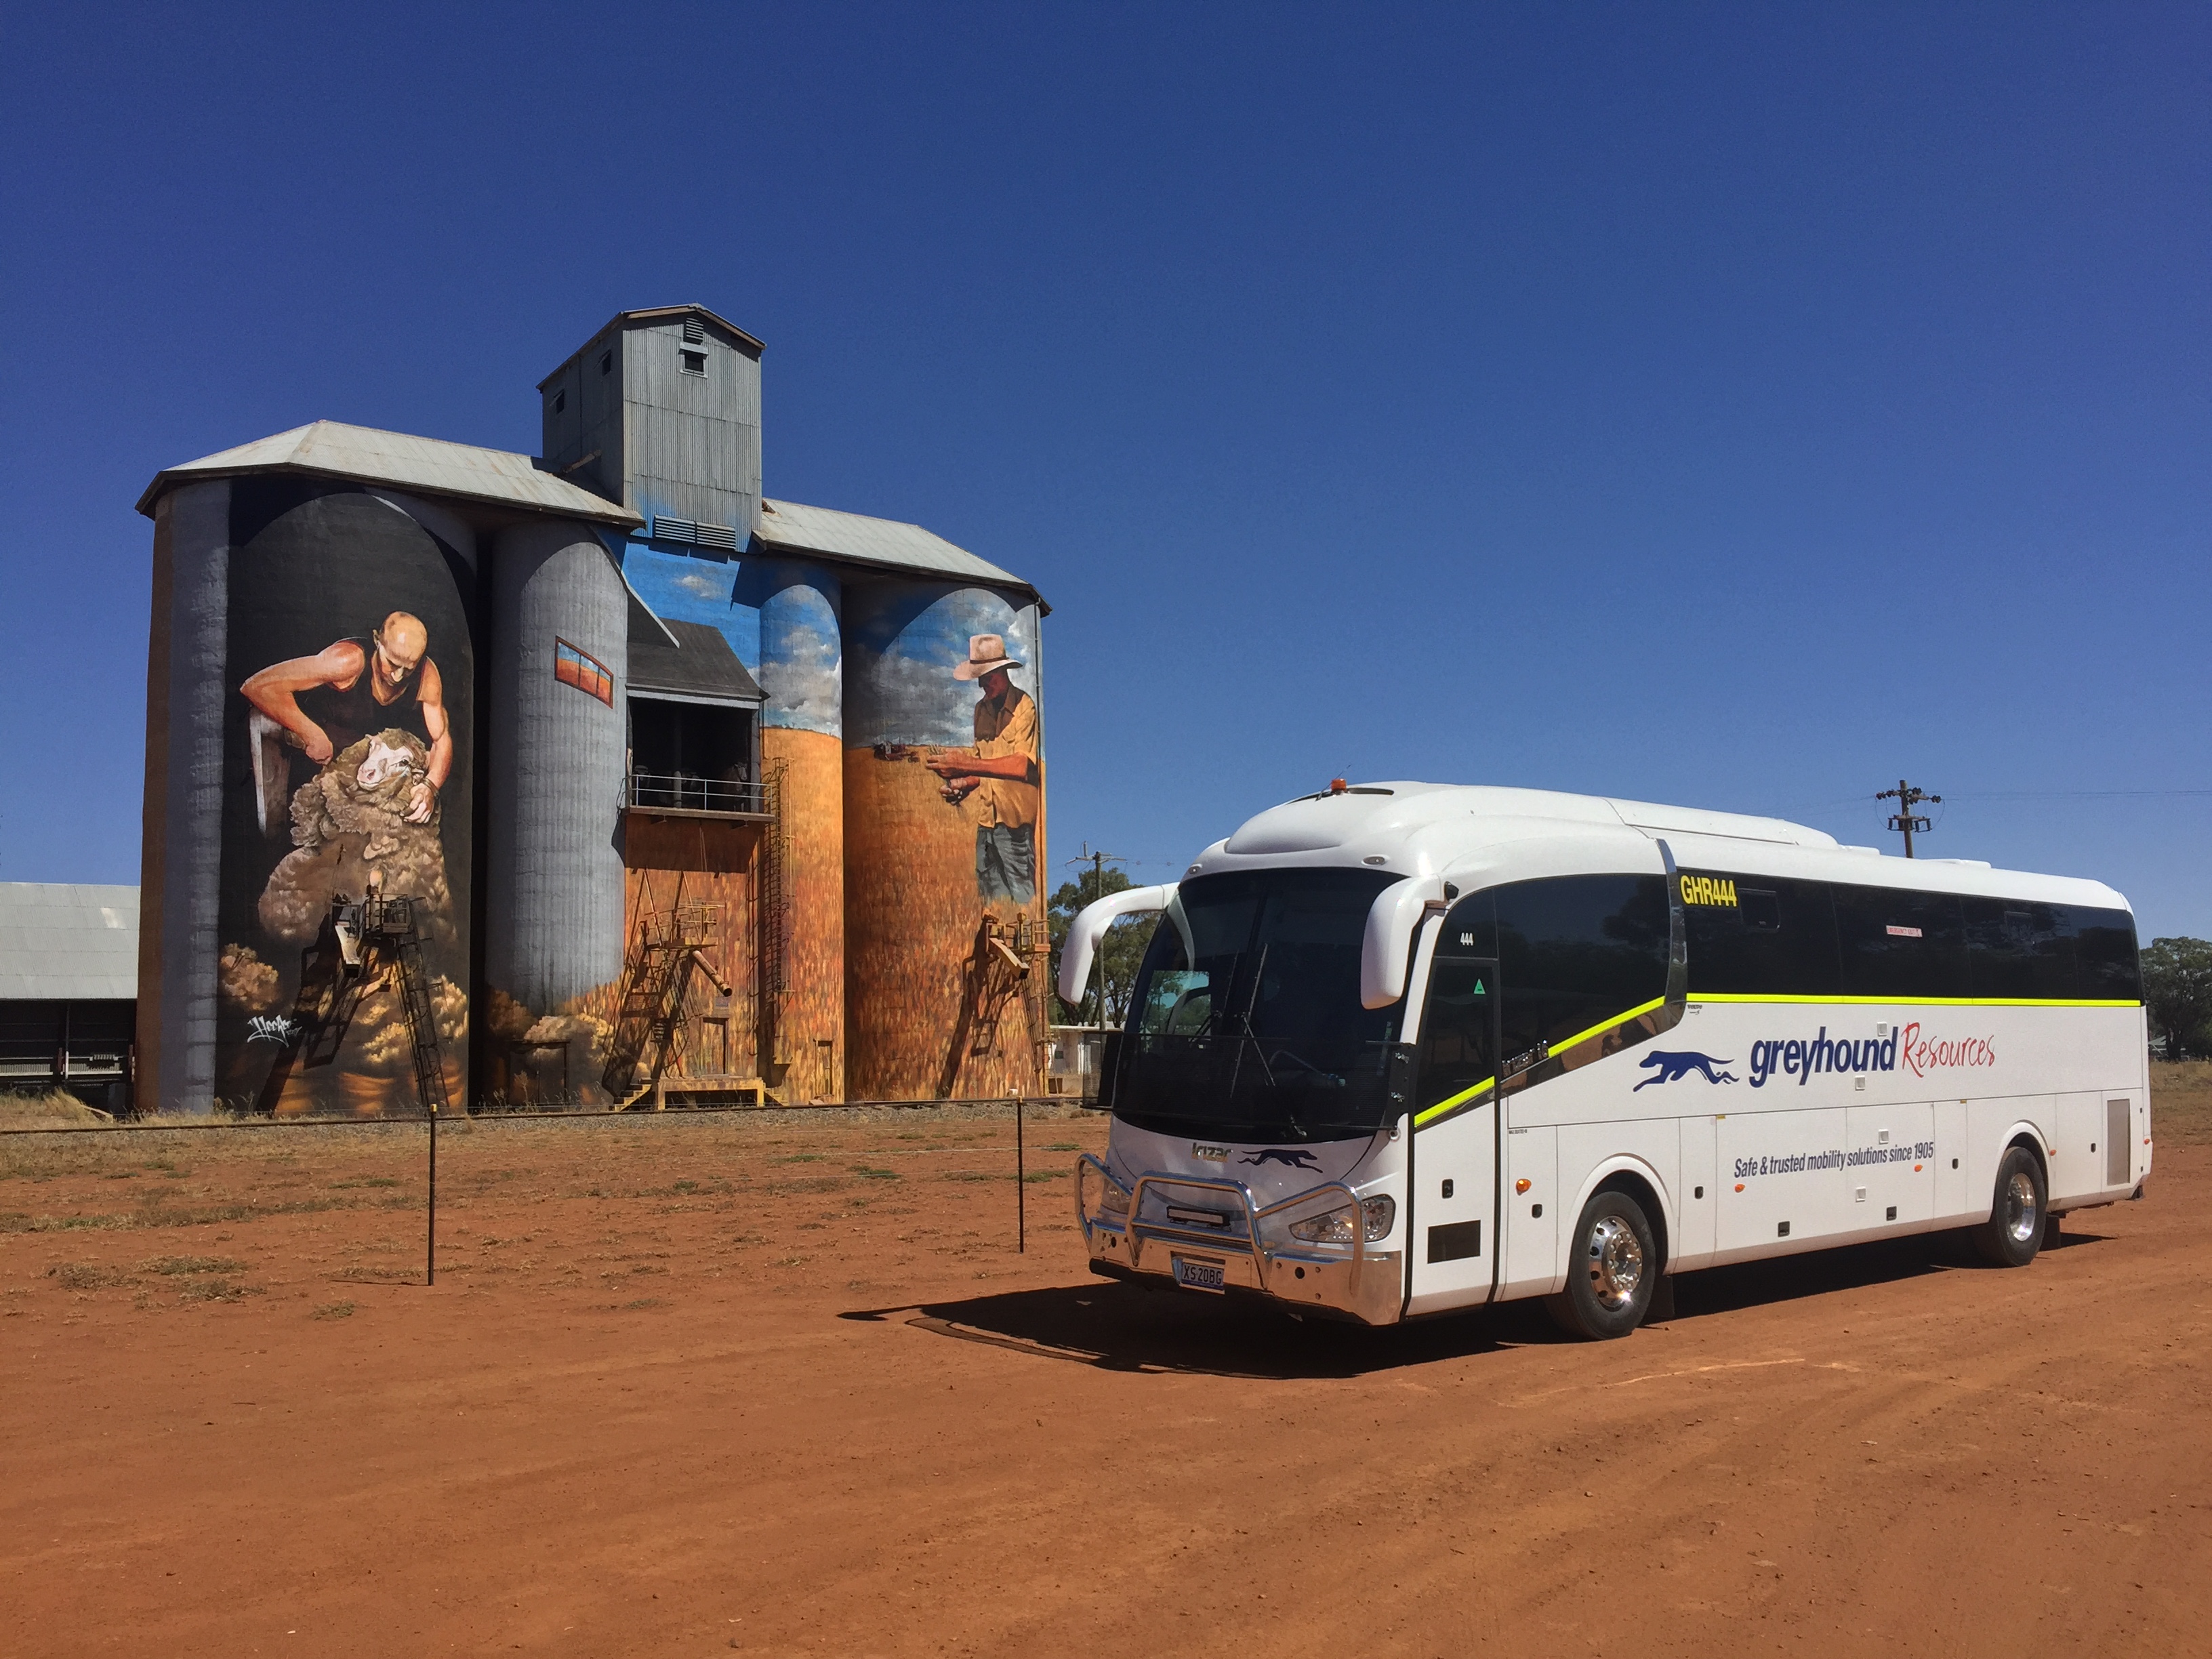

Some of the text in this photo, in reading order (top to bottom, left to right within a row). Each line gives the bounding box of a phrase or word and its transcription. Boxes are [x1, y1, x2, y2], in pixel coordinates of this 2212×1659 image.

[1681, 875, 1737, 907] GHR444
[1460, 933, 1473, 945] 444
[1749, 1022, 1995, 1088] greyhound Resources
[1734, 1142, 1934, 1178] Safe & trusted mobility solutions since 1905
[1184, 1265, 1222, 1284] XS 20BG
